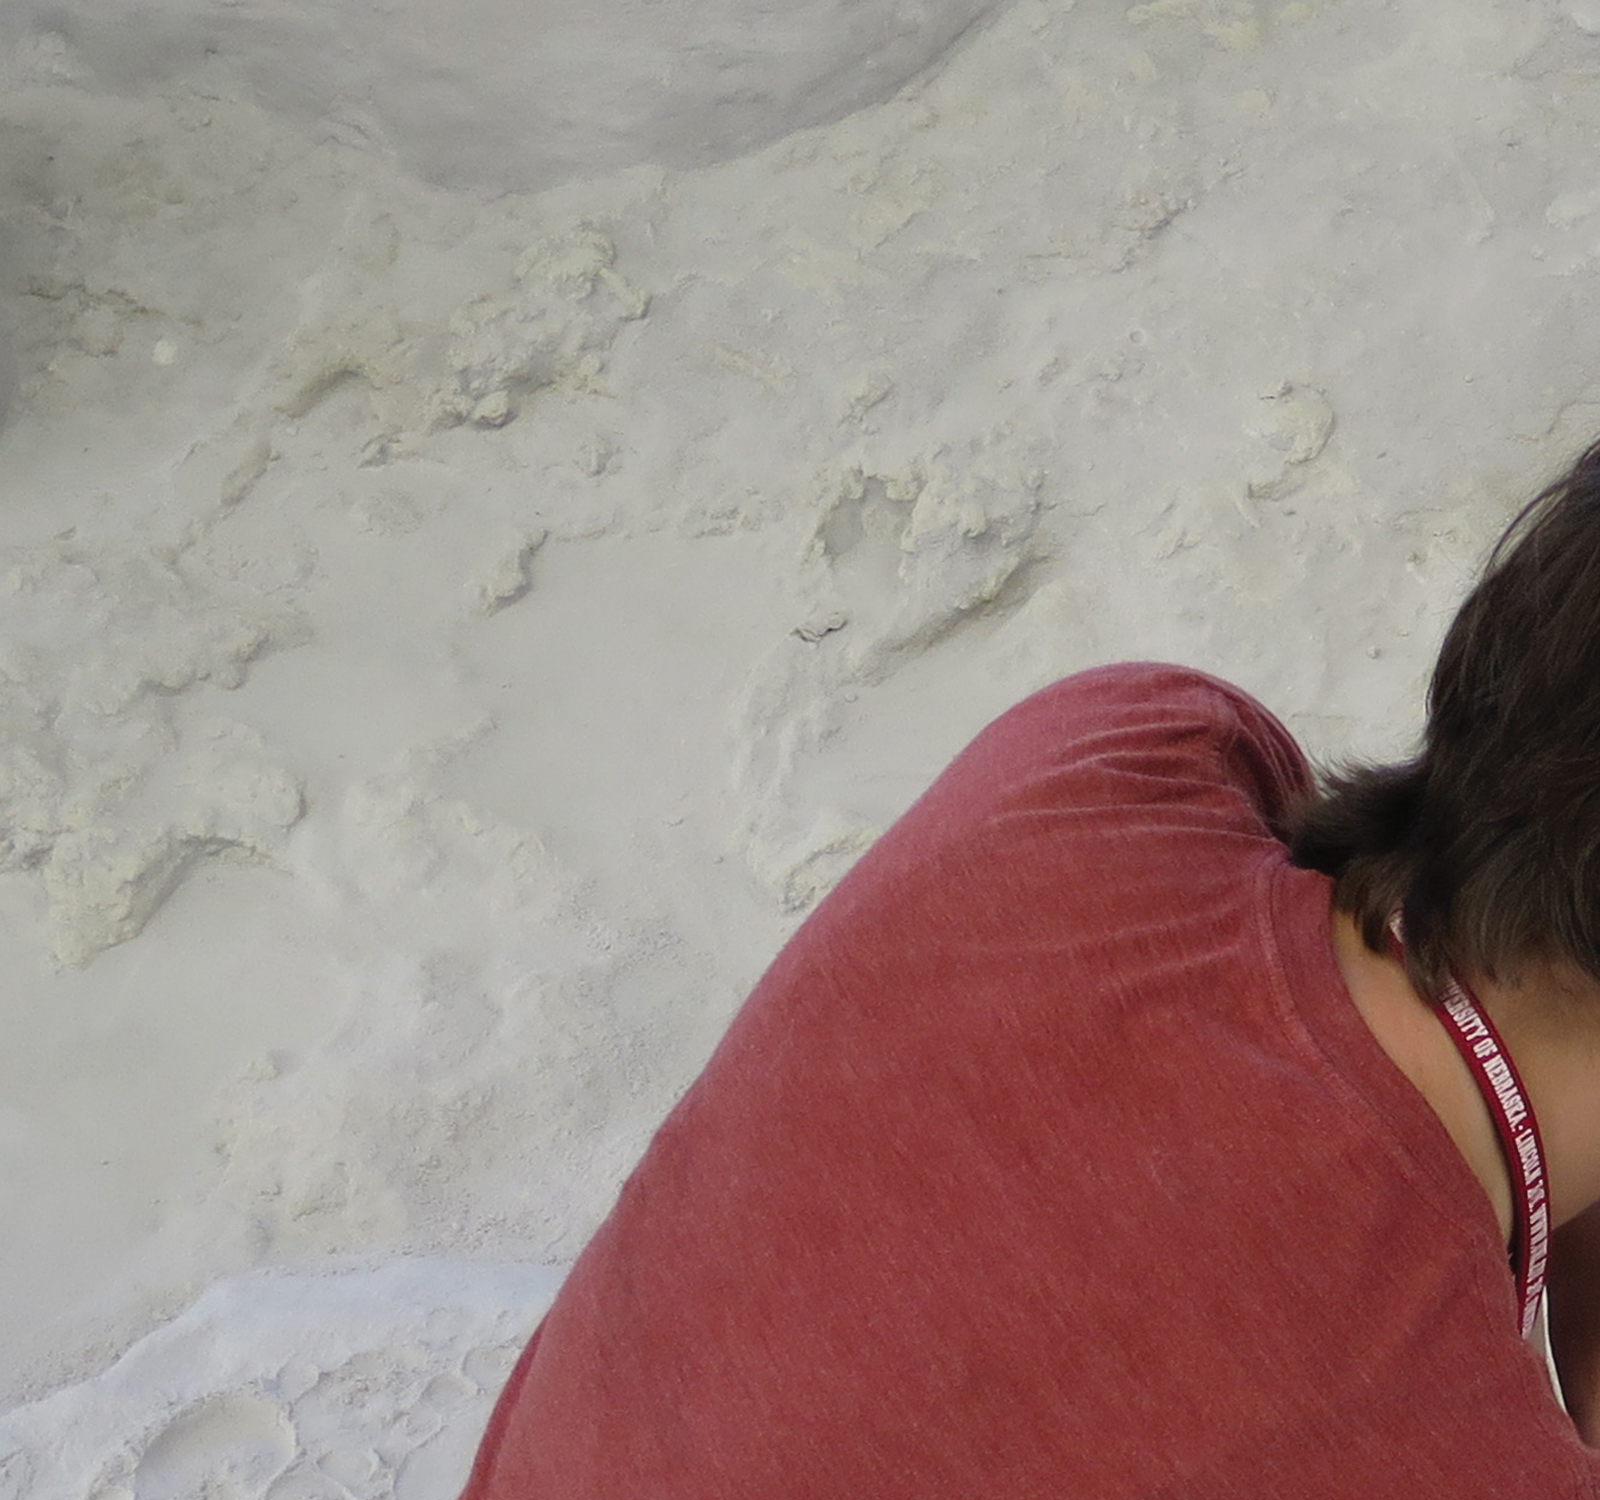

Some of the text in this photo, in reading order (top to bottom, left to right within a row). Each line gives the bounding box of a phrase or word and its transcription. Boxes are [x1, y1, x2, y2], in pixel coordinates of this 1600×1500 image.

[1473, 1037, 1498, 1059] OF
[1482, 1053, 1528, 1132] NEBRASKA
[1515, 1128, 1542, 1186] LINCOLN
